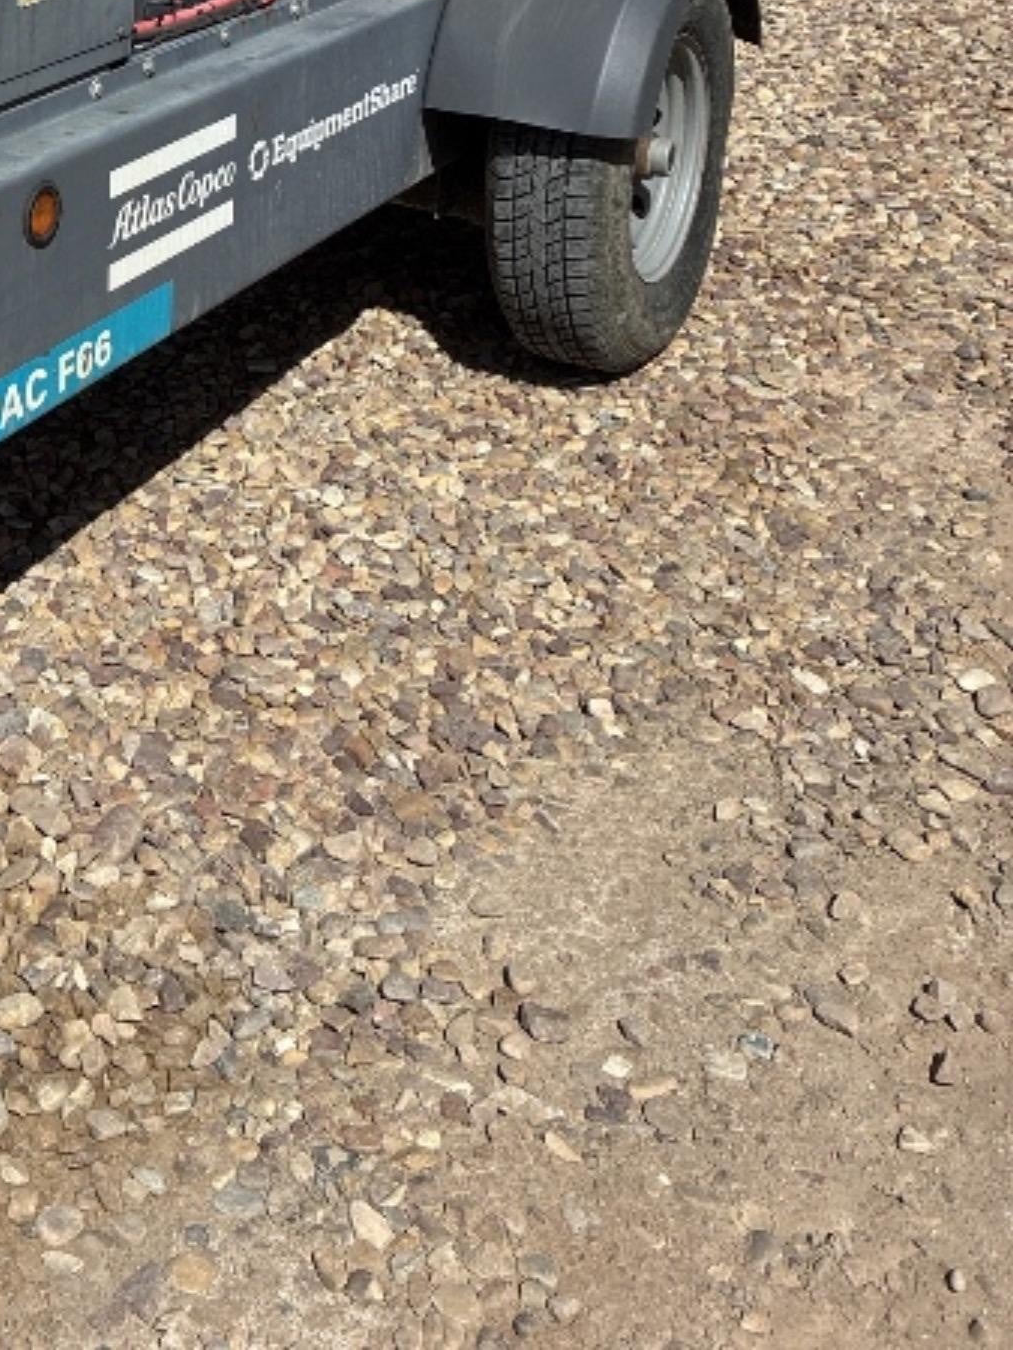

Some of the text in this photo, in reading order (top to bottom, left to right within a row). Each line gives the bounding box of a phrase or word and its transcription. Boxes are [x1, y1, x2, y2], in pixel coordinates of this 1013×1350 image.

[271, 69, 420, 166] EquipmentShare
[106, 160, 238, 250] Atlas Copco
[58, 328, 112, 394] F66
